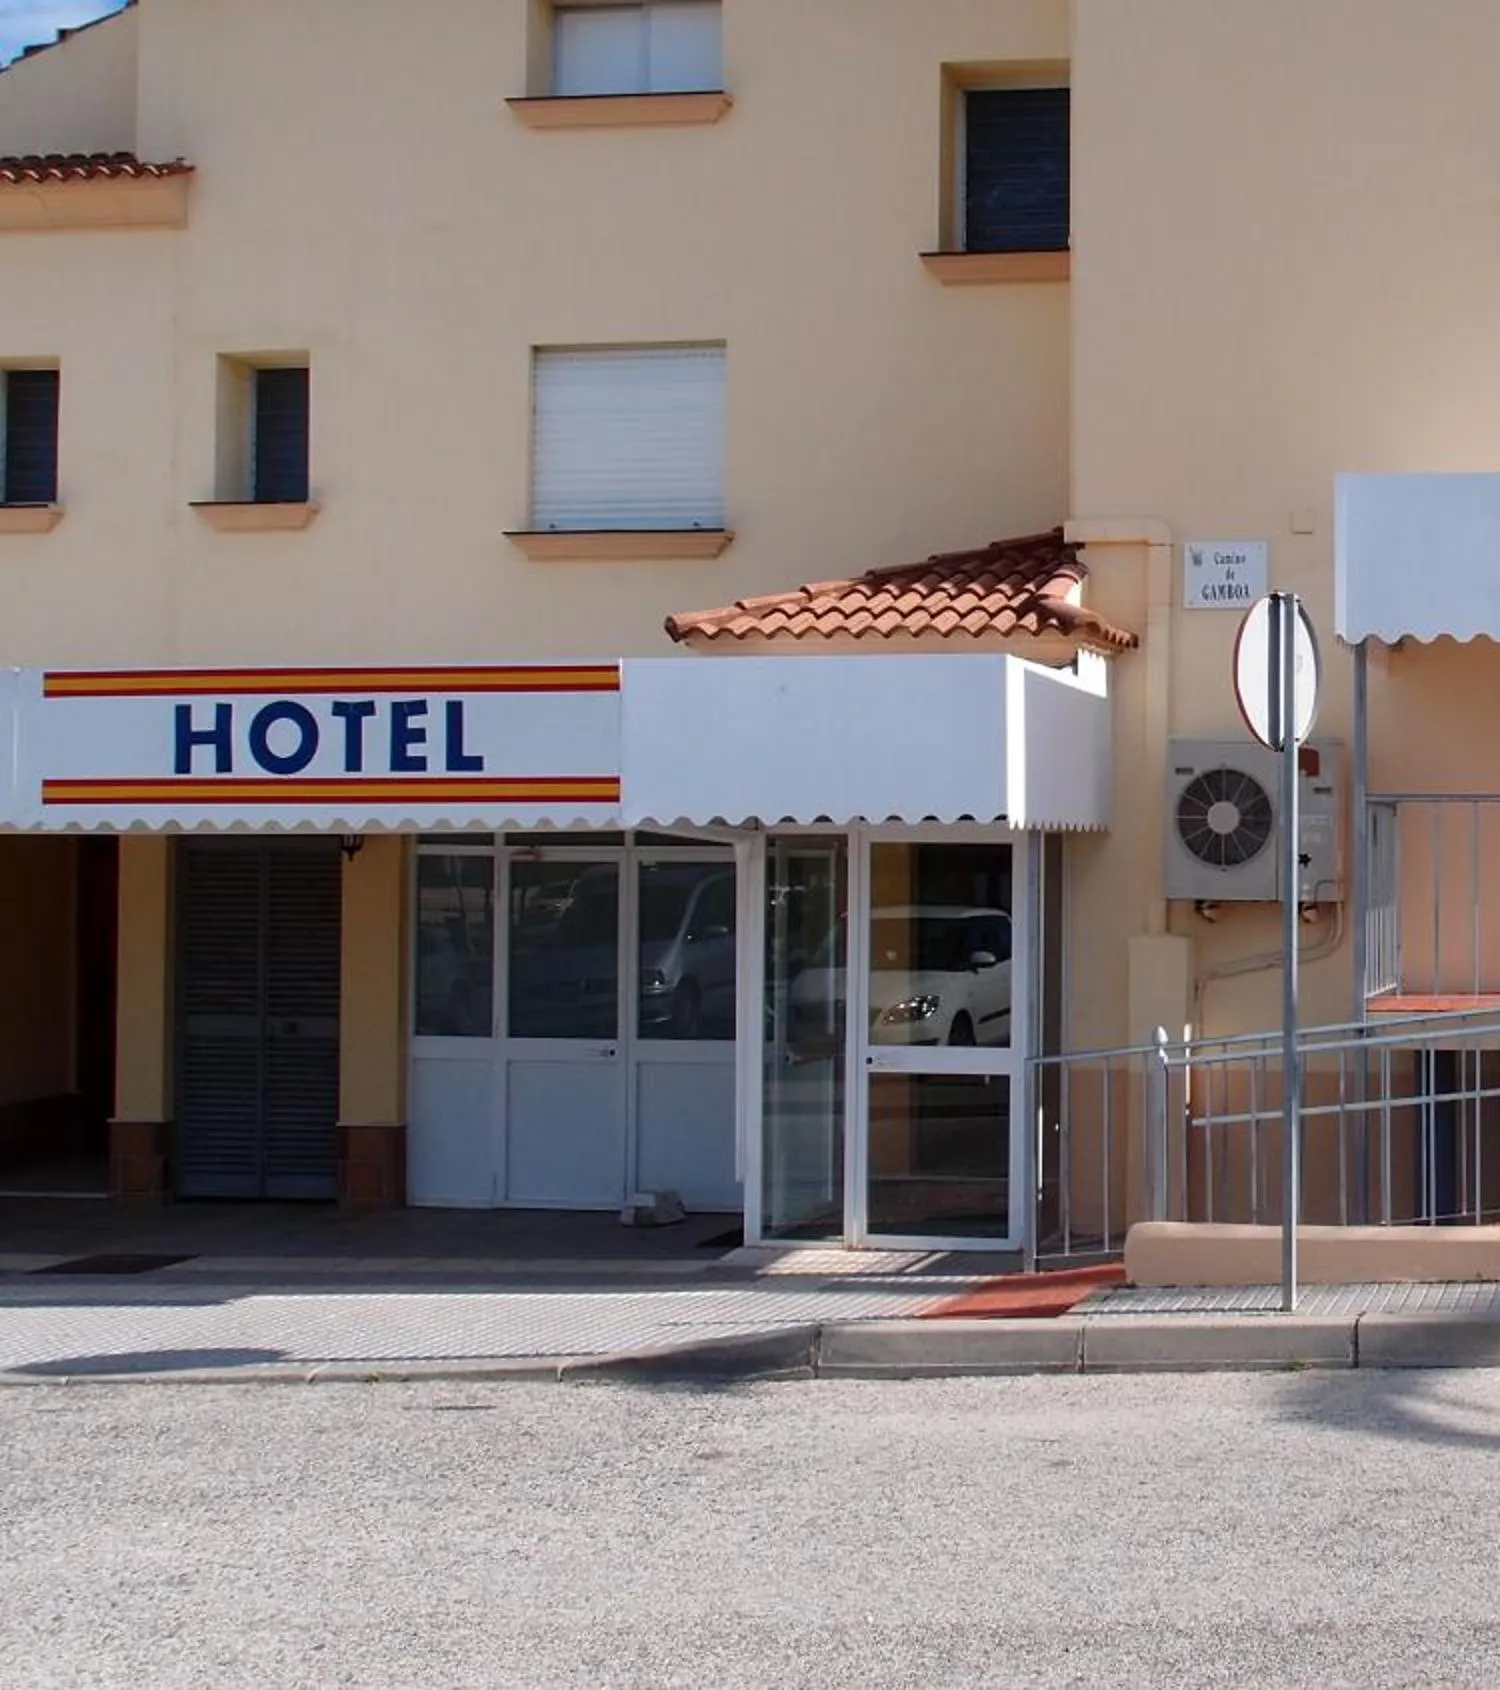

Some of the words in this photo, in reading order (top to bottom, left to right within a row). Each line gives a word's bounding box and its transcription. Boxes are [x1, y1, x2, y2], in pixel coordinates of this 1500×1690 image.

[1213, 552, 1247, 565] Camino
[1225, 567, 1236, 580] de
[1201, 583, 1251, 601] GAMBOA
[173, 698, 485, 775] HOTEL
